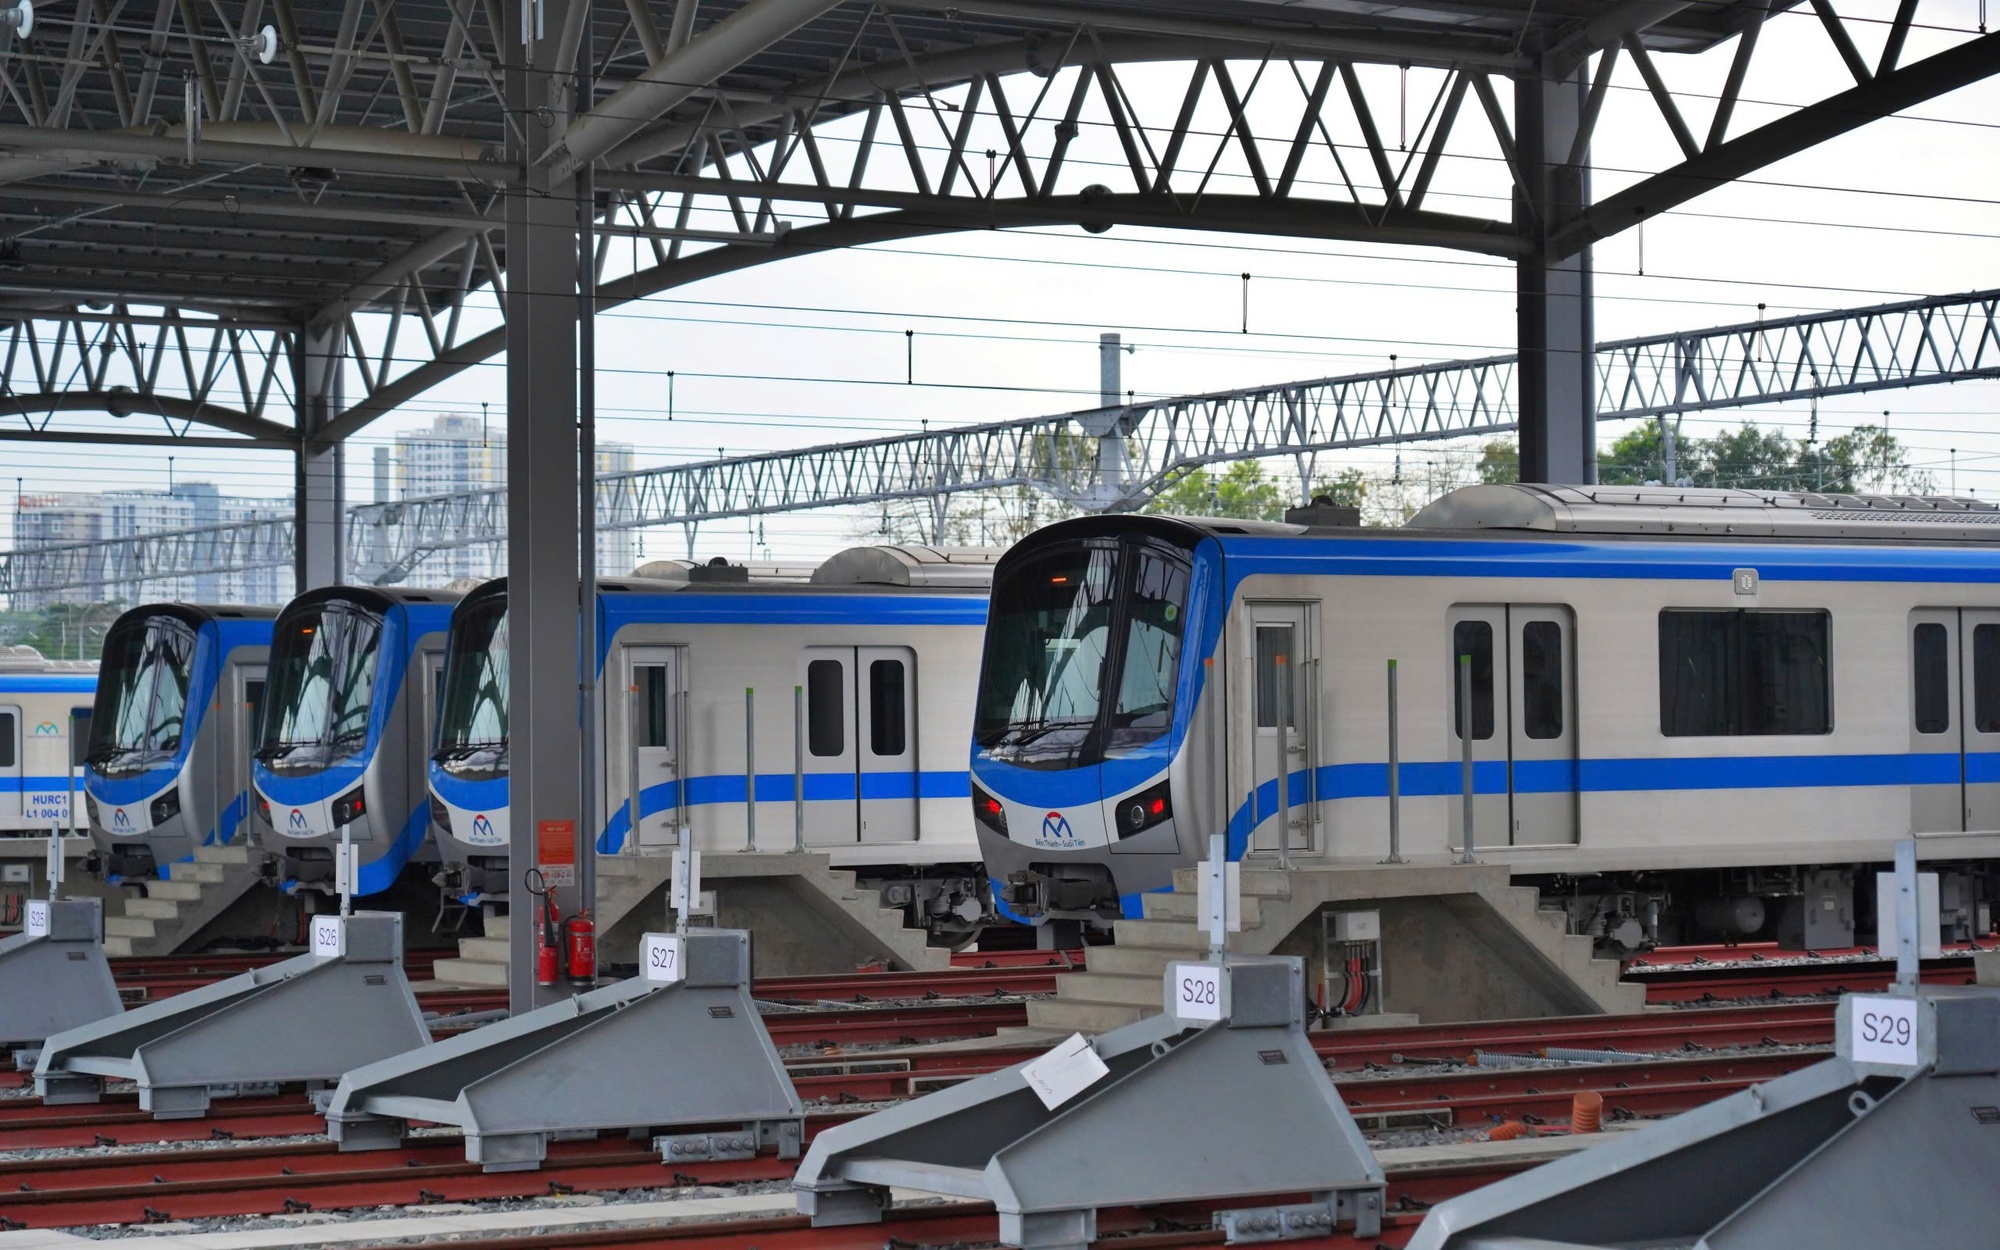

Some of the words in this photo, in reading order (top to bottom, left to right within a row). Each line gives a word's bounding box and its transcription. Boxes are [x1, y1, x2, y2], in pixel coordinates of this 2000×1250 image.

[32, 795, 67, 805] HURC1
[26, 809, 38, 819] L1
[41, 809, 59, 819] 004
[31, 910, 44, 927] S25
[319, 927, 337, 946] S26
[652, 947, 675, 968] S27
[1183, 978, 1215, 1004] S28
[1863, 1012, 1910, 1046] S29
